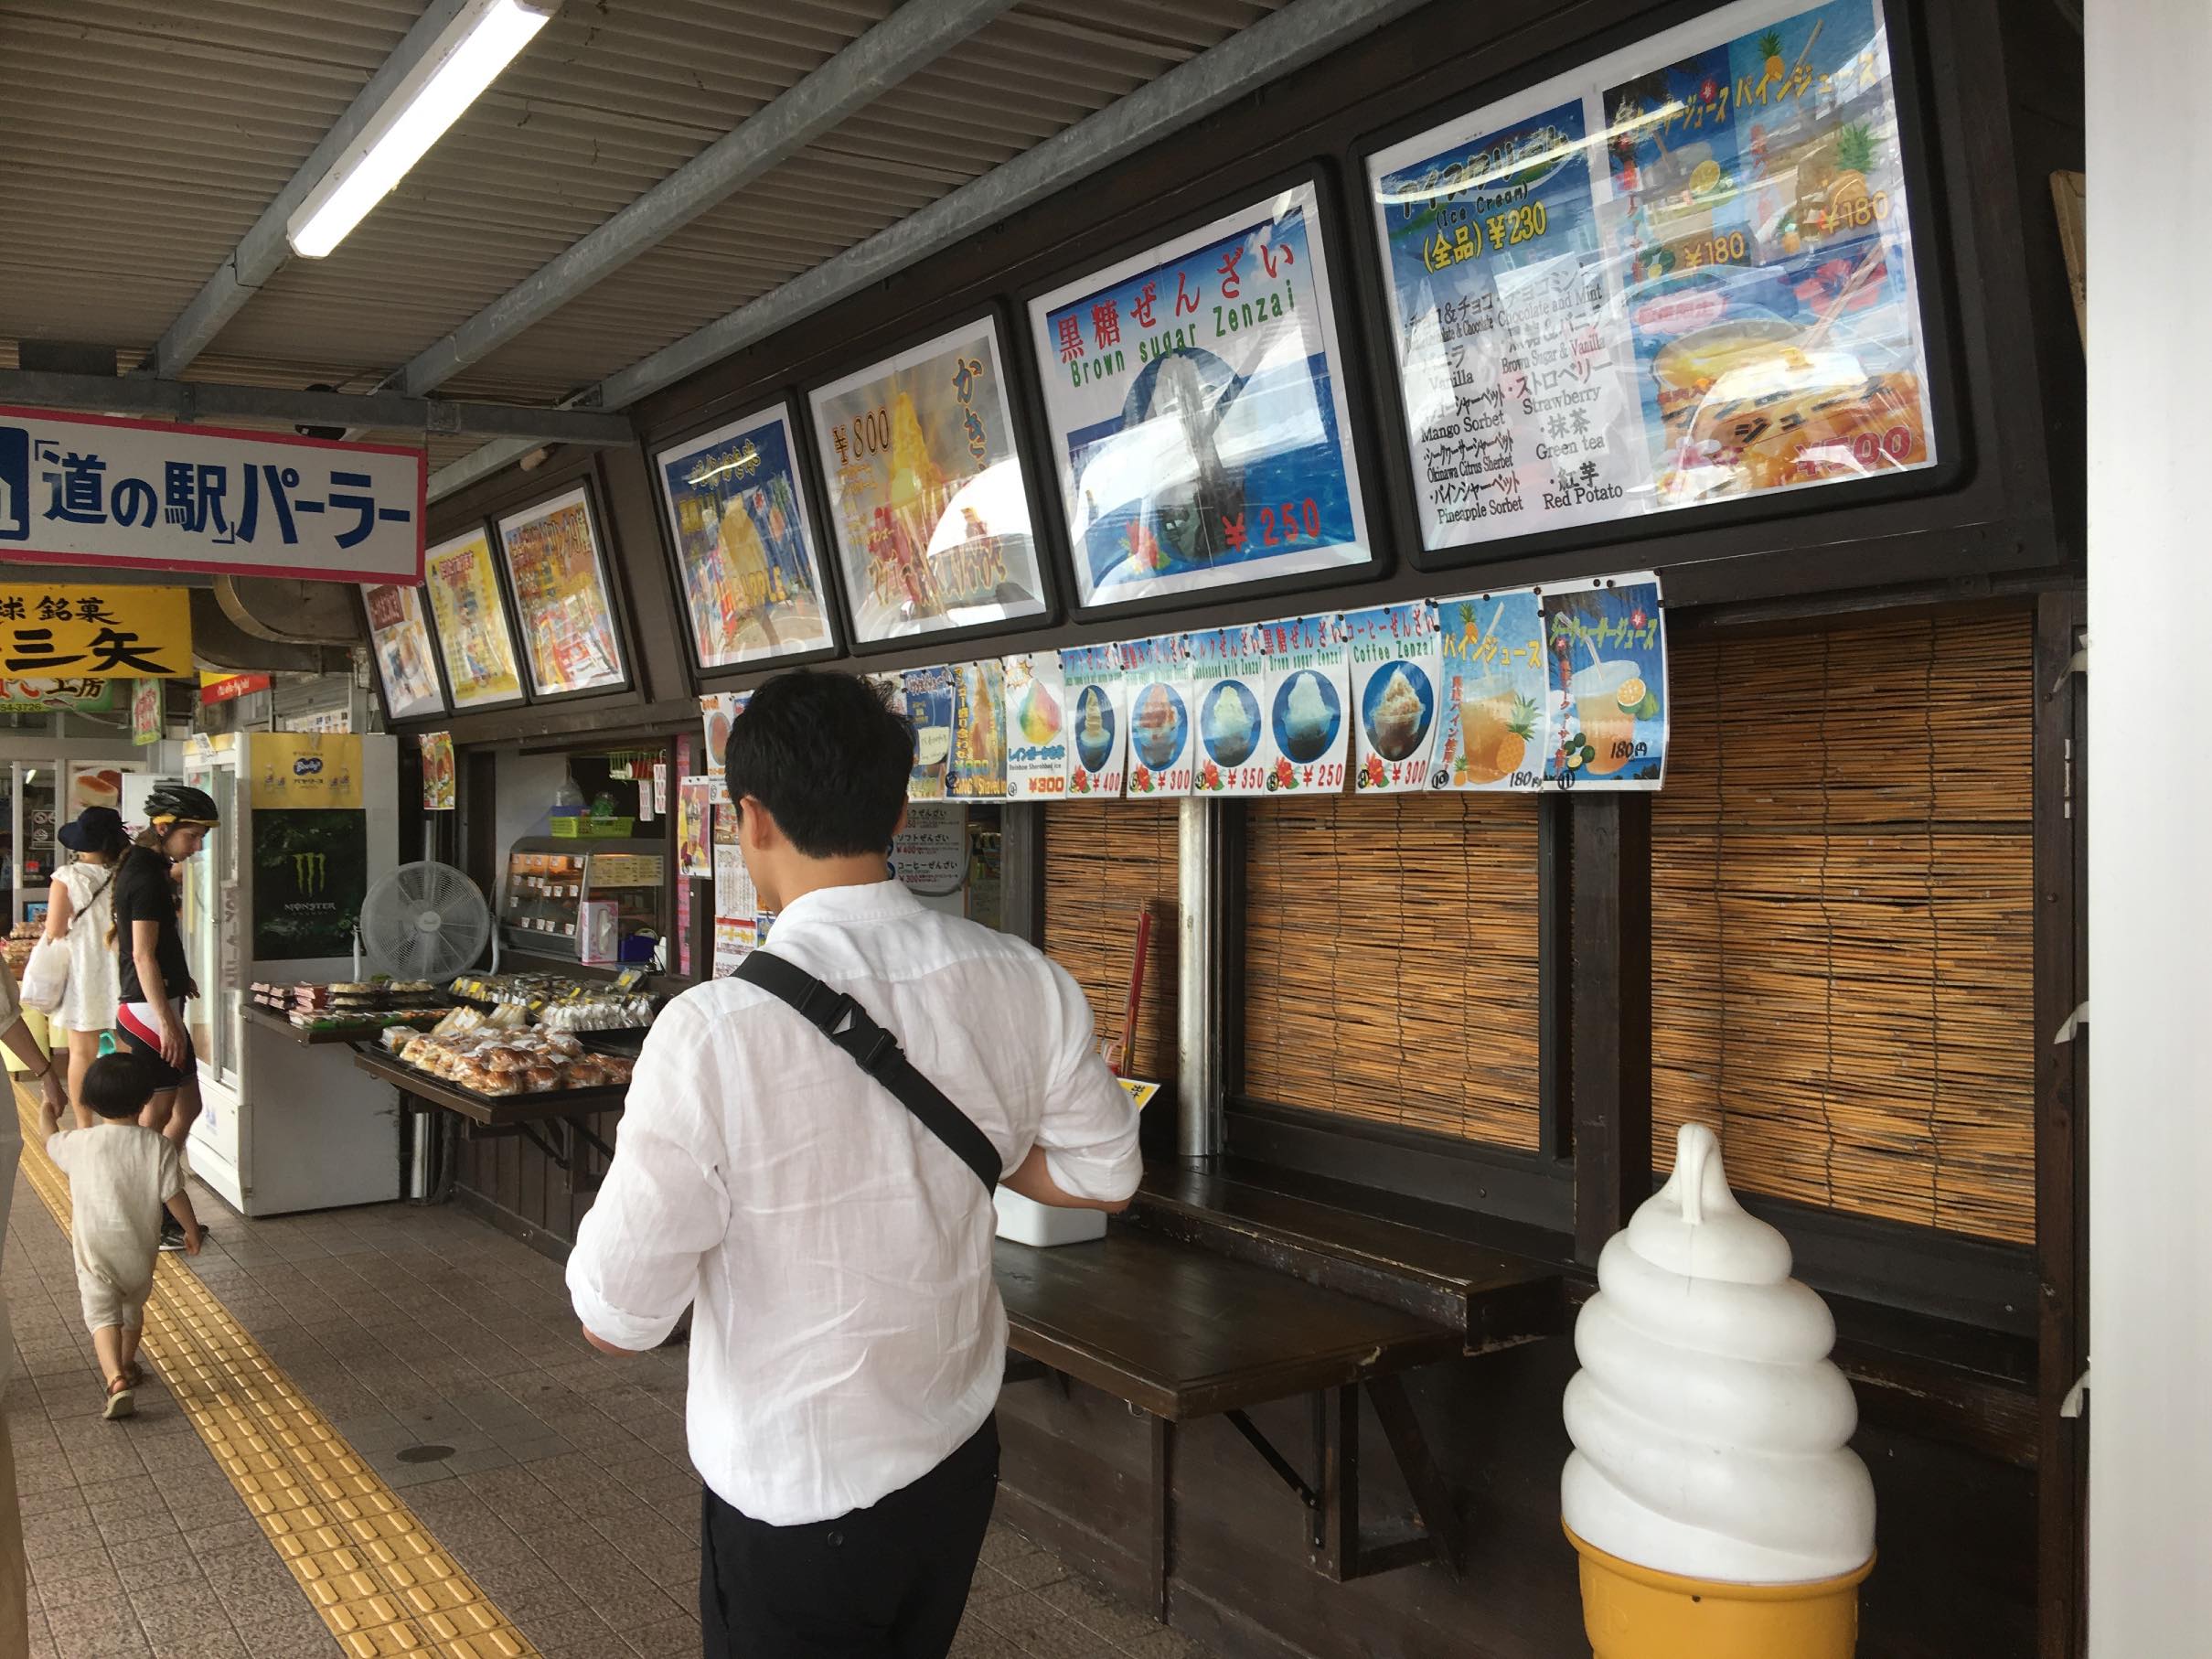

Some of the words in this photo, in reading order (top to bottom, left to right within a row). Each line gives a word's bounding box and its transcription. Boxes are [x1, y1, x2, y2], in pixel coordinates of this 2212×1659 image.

[1476, 180, 1528, 214] Cream)
[1424, 221, 1483, 274] (全品)
[1486, 199, 1547, 250] ¥230
[1683, 230, 1746, 266] ¥180
[1057, 243, 1294, 364] 黒糖ぜんざい
[1553, 294, 1574, 312] and
[1575, 283, 1603, 306] Mint
[1070, 348, 1126, 388] Brown
[1139, 322, 1197, 364] sugar
[1213, 278, 1296, 337] Zenzai
[1501, 353, 1530, 375] Brown
[1531, 347, 1558, 369] Sugar
[1571, 336, 1606, 357] Vanilla
[1421, 423, 1460, 444] Mango
[1463, 410, 1505, 433] Sorbet
[1523, 384, 1601, 415] Strawberry
[832, 405, 890, 466] ¥800
[1427, 463, 1459, 484] Okinawa
[1459, 459, 1482, 477] Citrus
[1483, 452, 1514, 473] Sherbet
[1536, 440, 1577, 460] Green
[1581, 433, 1606, 451] tea
[1437, 502, 1488, 524] Pineapple
[1488, 495, 1524, 516] Sorbet
[1543, 493, 1572, 510] Red
[1576, 483, 1623, 506] Potato
[1353, 644, 1391, 663] Coffee
[1395, 637, 1434, 658] Zenzai
[1442, 631, 1543, 669] パインジュース
[1028, 776, 1064, 793] ¥300
[284, 902, 337, 911] MONSTER
